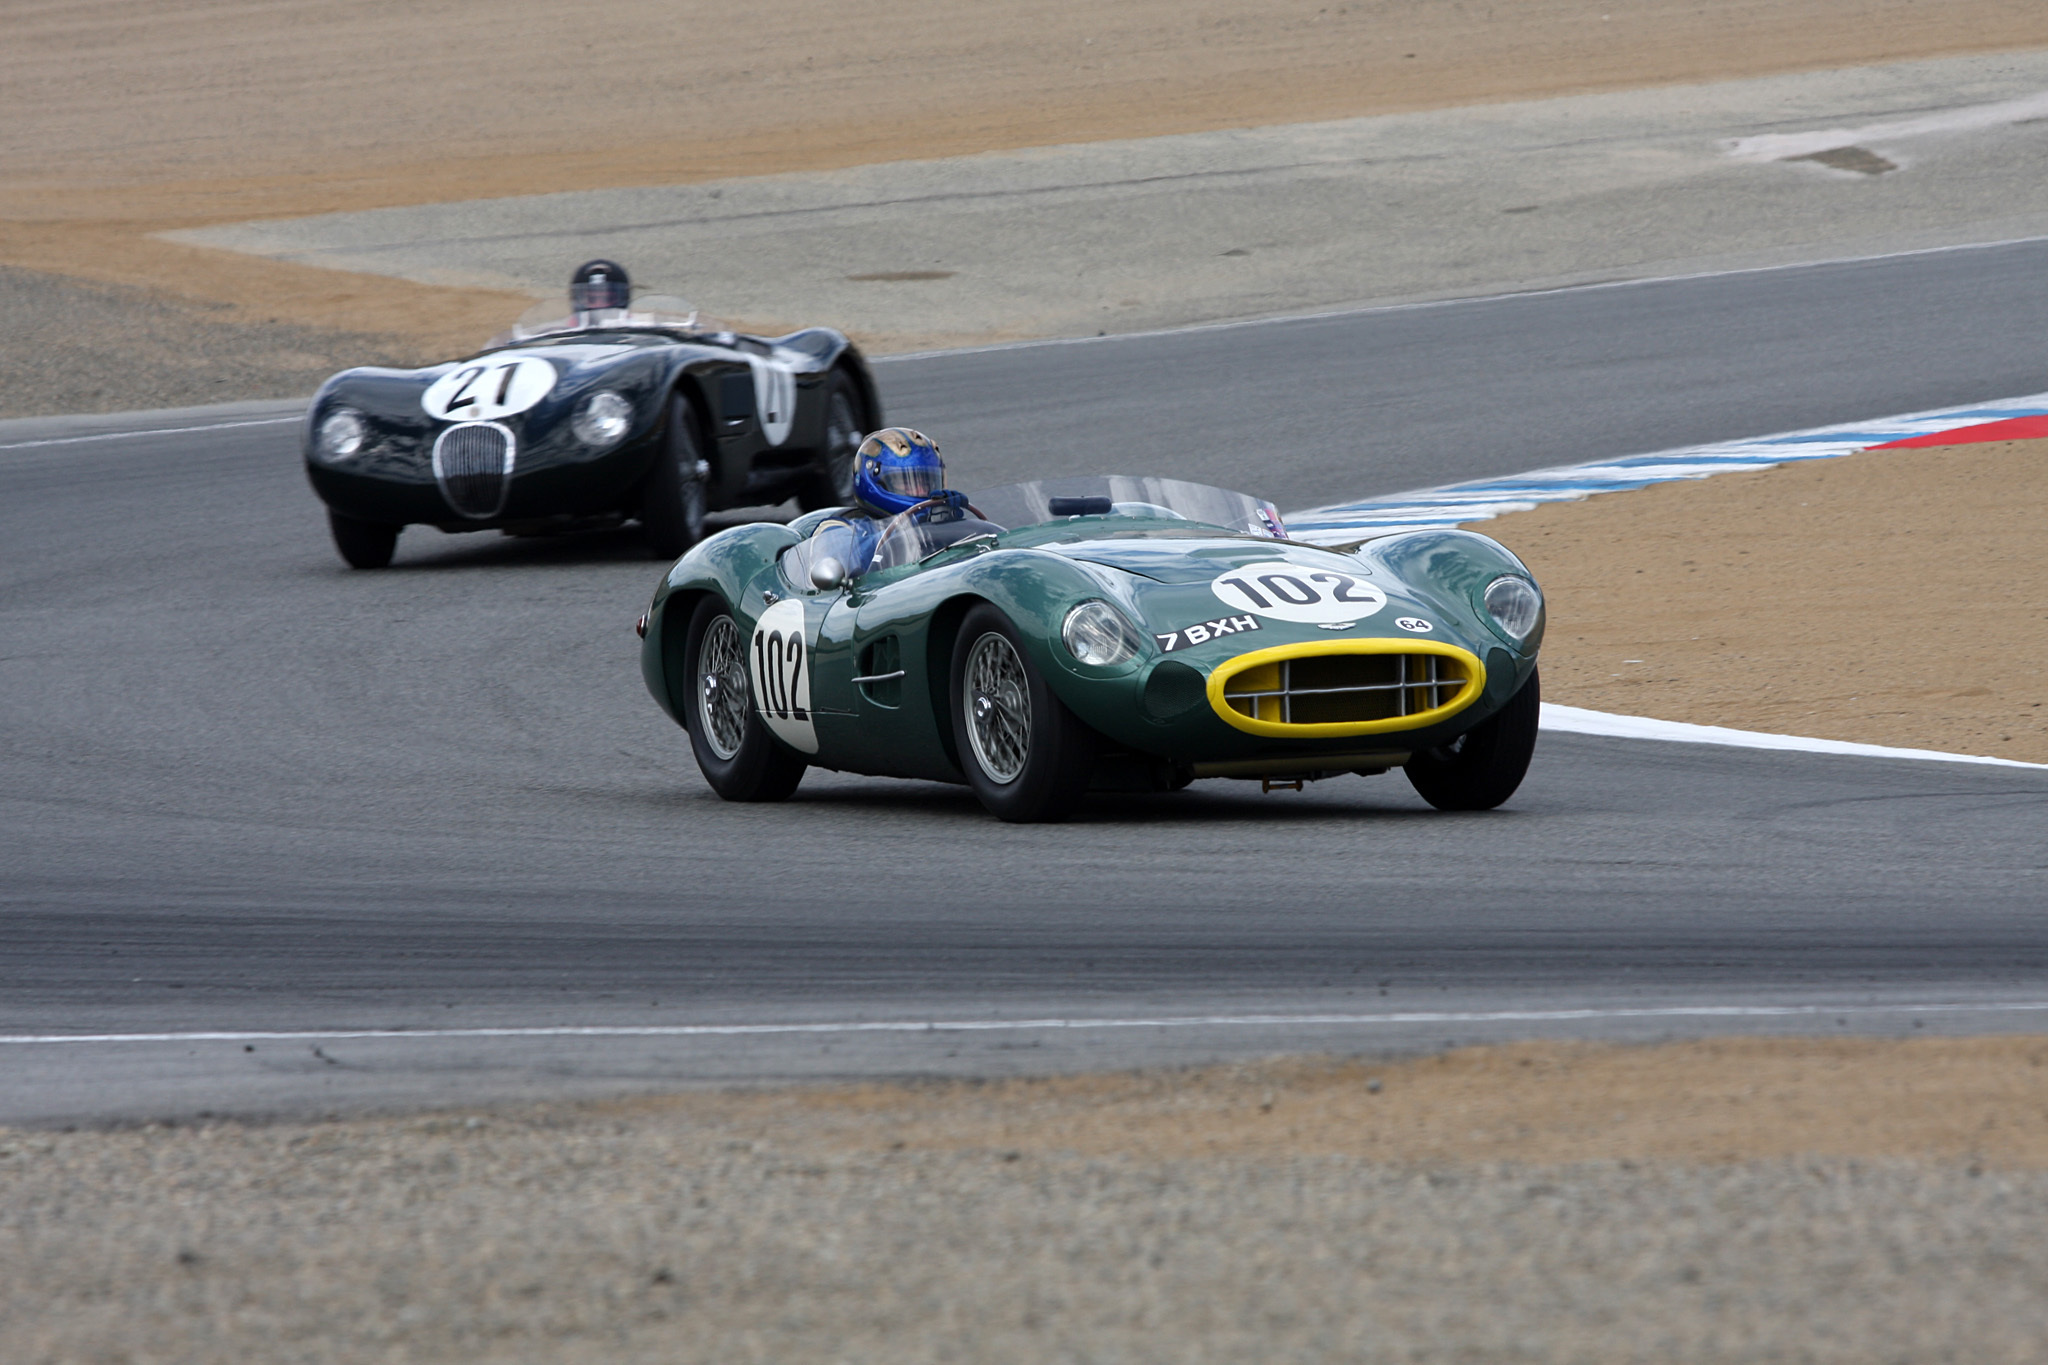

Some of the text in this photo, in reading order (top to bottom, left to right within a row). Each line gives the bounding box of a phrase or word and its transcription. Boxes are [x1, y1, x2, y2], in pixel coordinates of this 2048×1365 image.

[444, 362, 521, 415] 21
[1220, 573, 1377, 608] 102
[1156, 615, 1259, 651] 7 BXH
[1400, 620, 1429, 630] 64
[755, 630, 809, 721] 102
